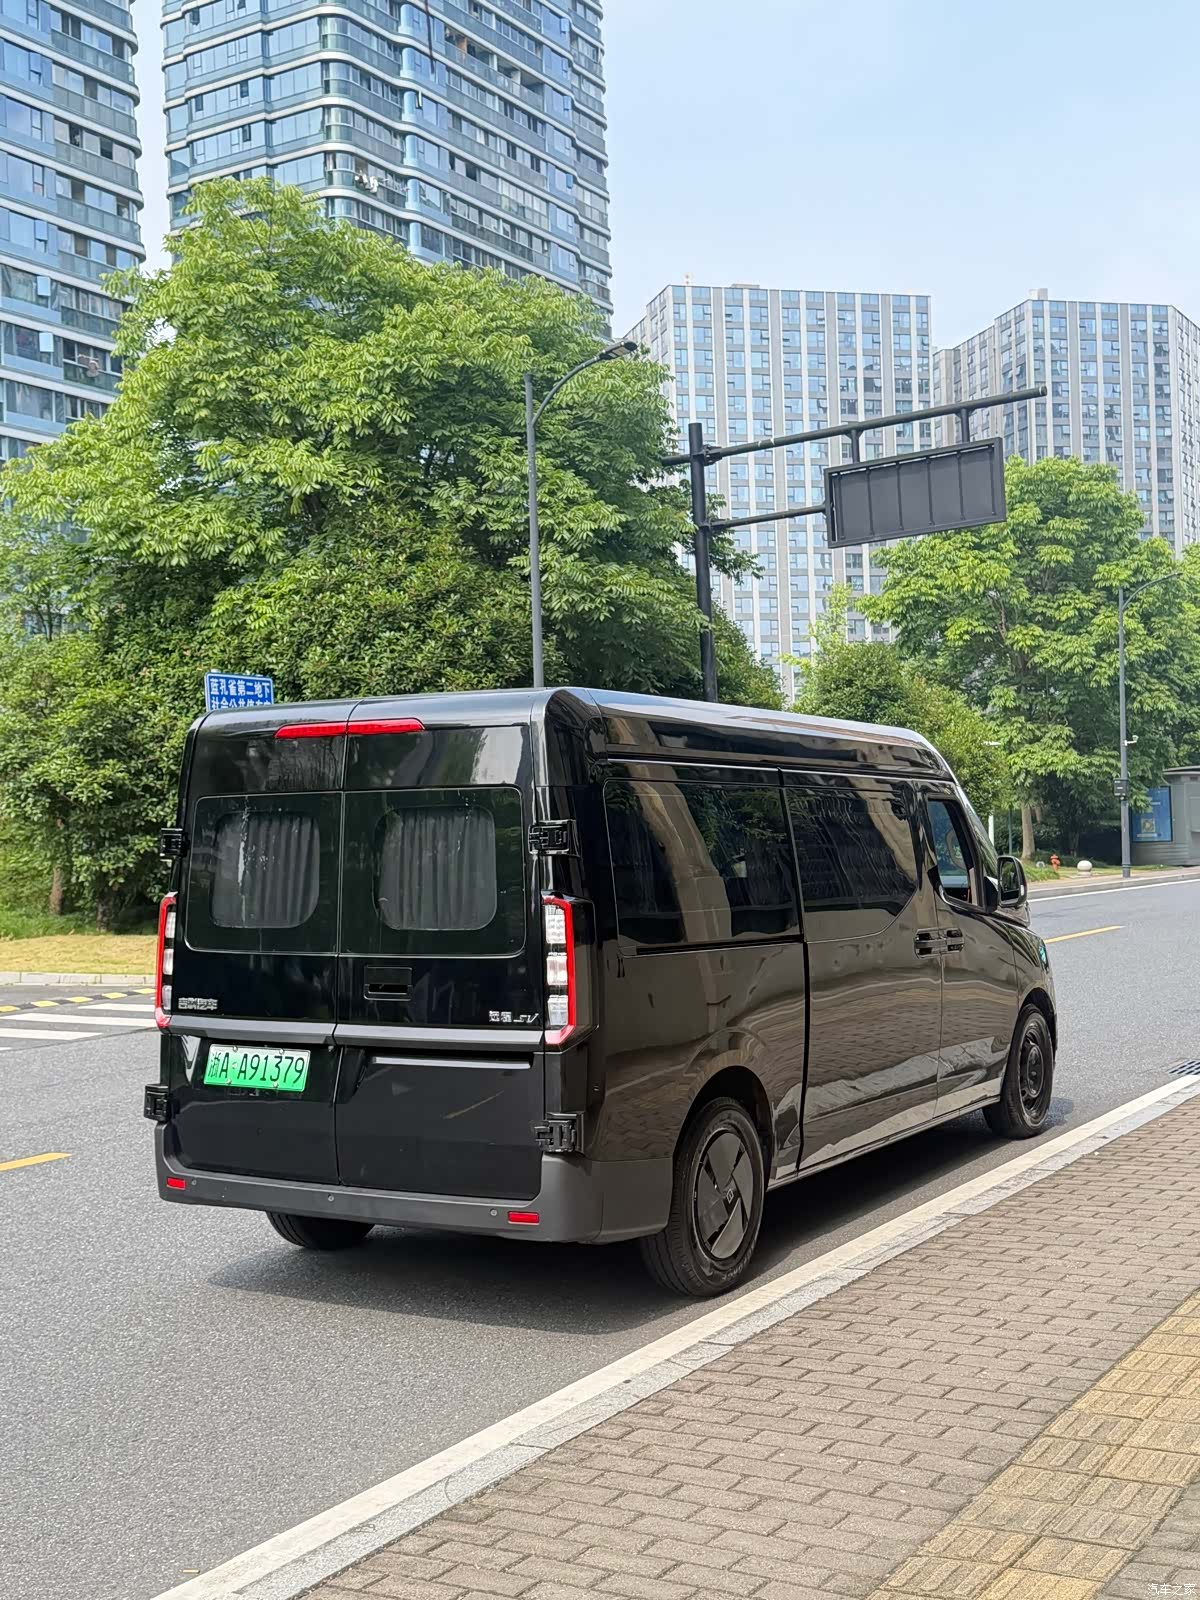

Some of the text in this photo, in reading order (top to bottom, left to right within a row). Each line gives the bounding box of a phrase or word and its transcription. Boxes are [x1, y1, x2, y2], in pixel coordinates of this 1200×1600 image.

[210, 678, 270, 698] 蓝孔雀第二地下
[513, 1013, 539, 1023] SV
